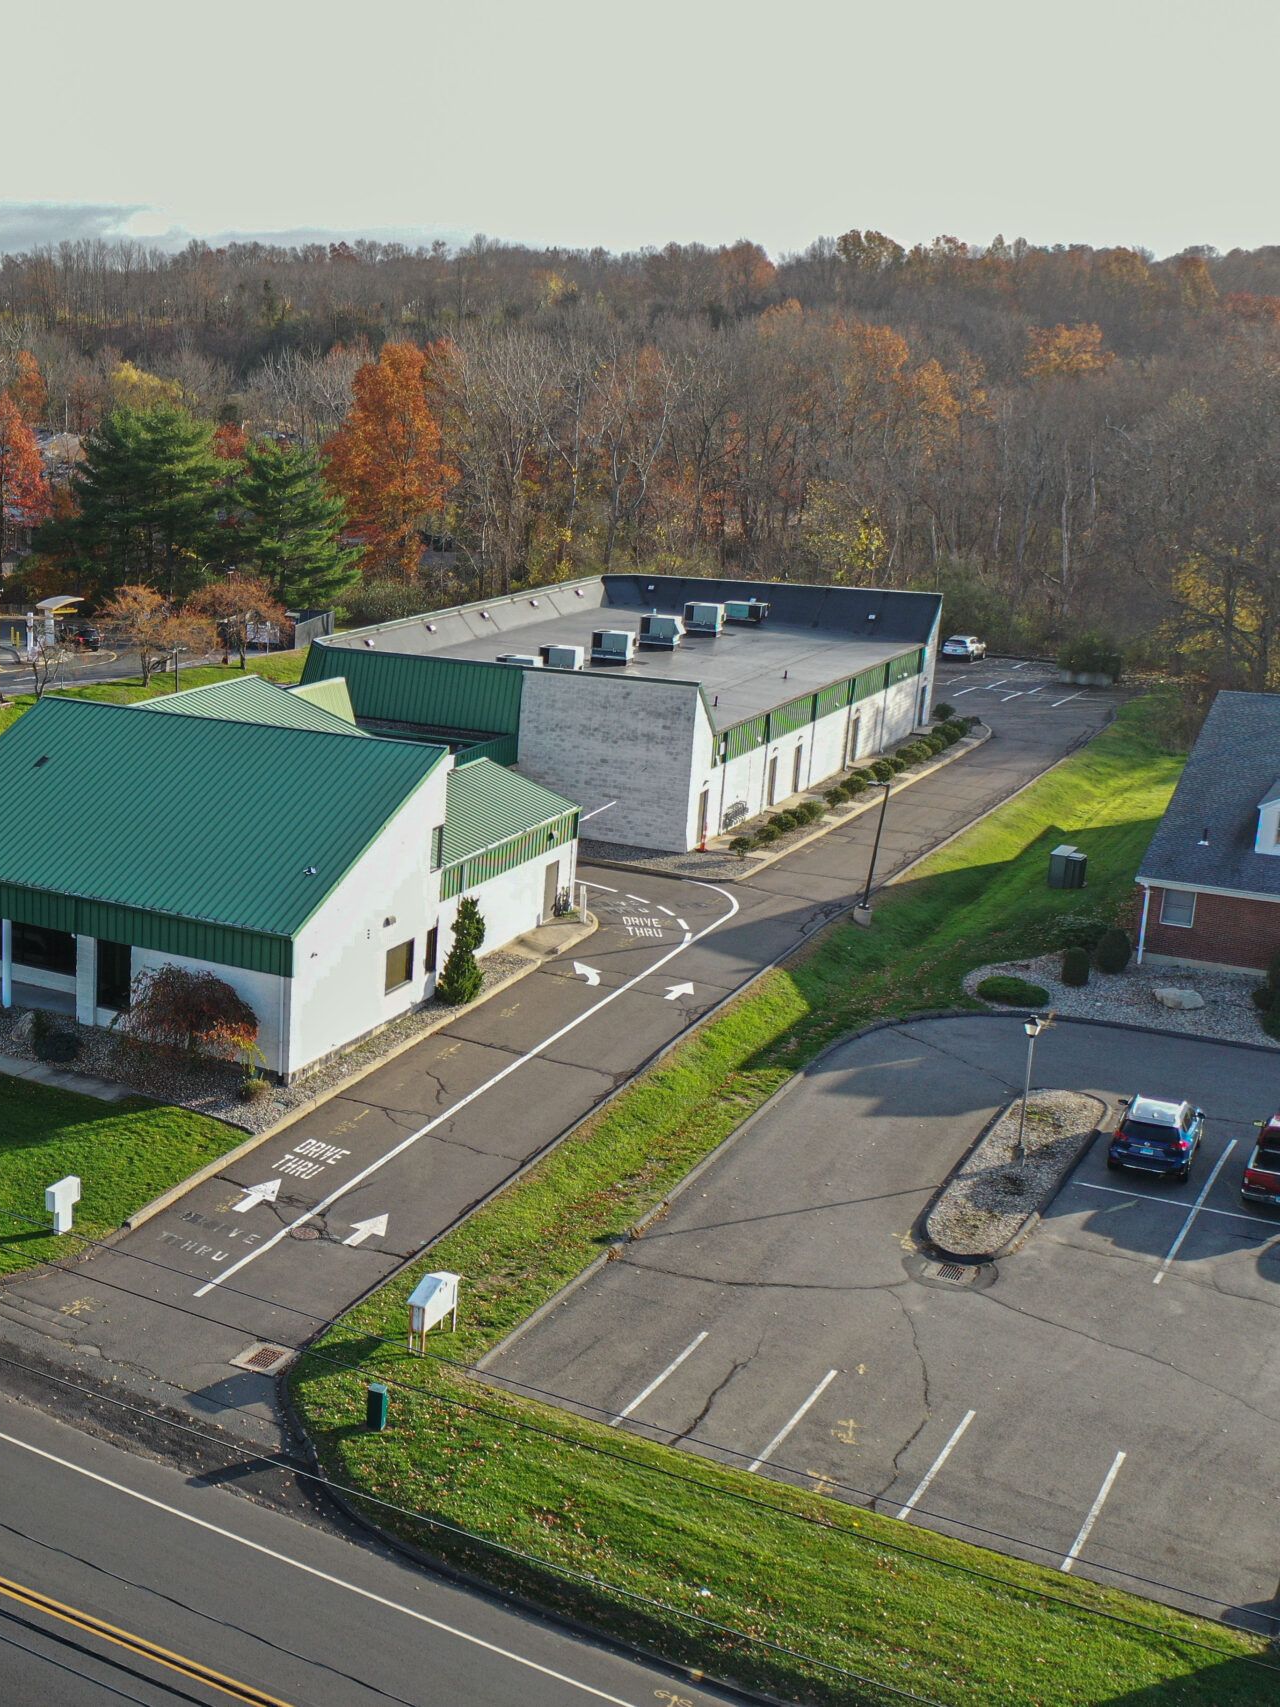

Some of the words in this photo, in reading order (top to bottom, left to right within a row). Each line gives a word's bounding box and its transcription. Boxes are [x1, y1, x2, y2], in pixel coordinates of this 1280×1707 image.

[622, 916, 662, 928] DRIVE
[625, 926, 663, 938] THRU
[292, 1138, 352, 1165] DRIVE
[271, 1153, 326, 1180] THRU
